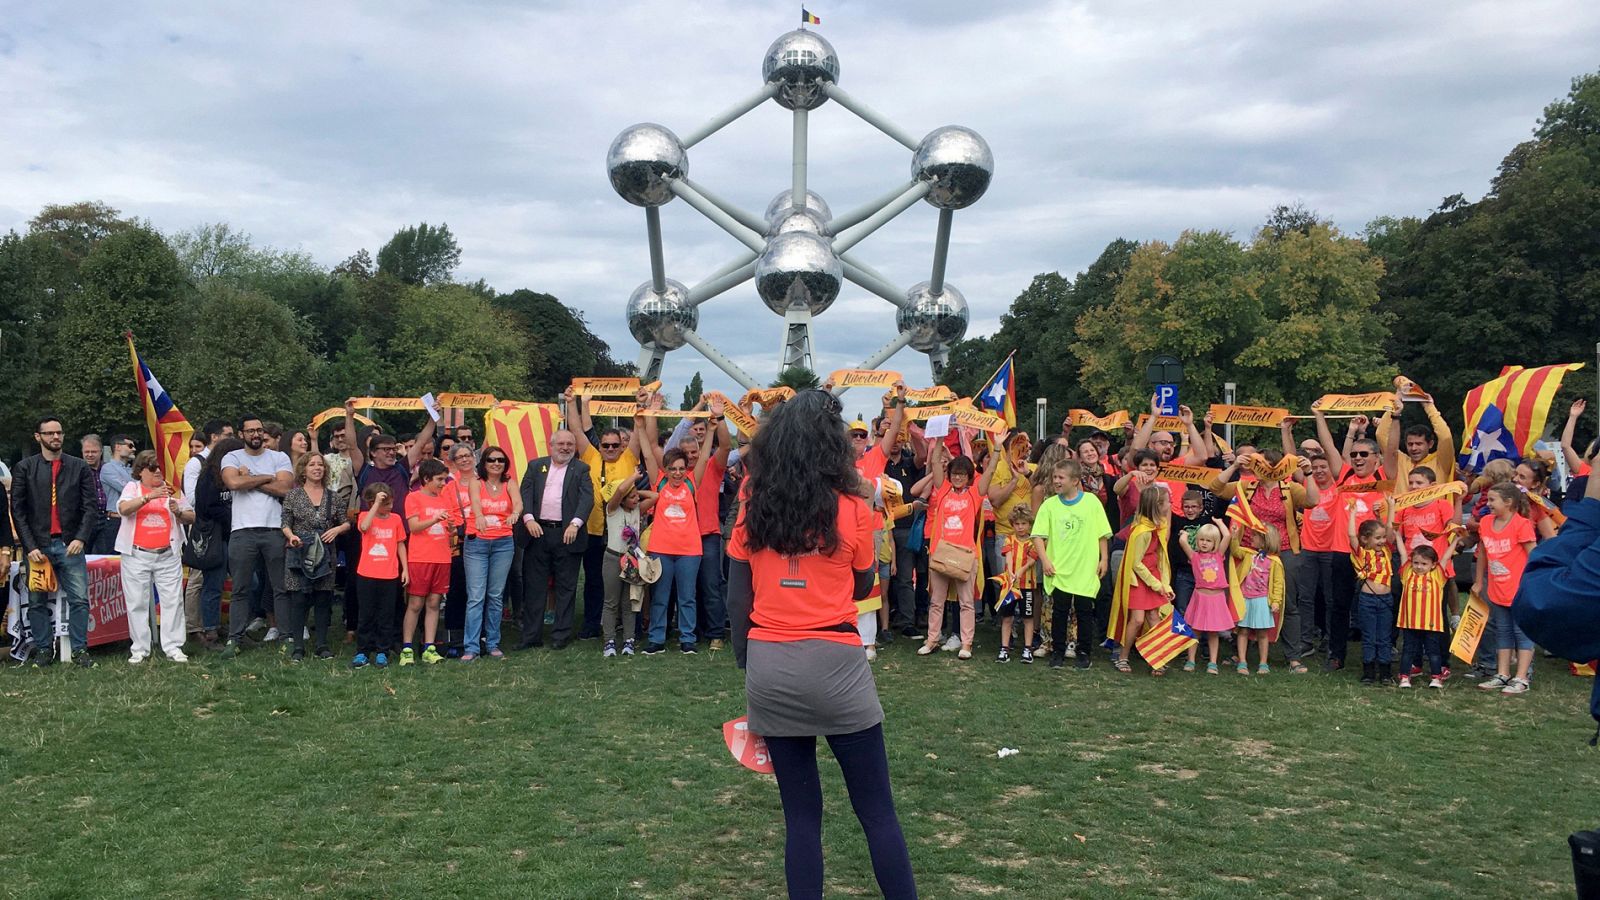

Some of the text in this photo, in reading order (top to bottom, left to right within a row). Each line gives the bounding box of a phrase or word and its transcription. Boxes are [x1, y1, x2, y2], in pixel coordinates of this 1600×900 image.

[1161, 387, 1173, 404] P
[94, 567, 103, 582] LA
[87, 572, 123, 610] EPÚBL
[1025, 591, 1033, 616] CAPTAIN
[100, 596, 128, 625] CATAL
